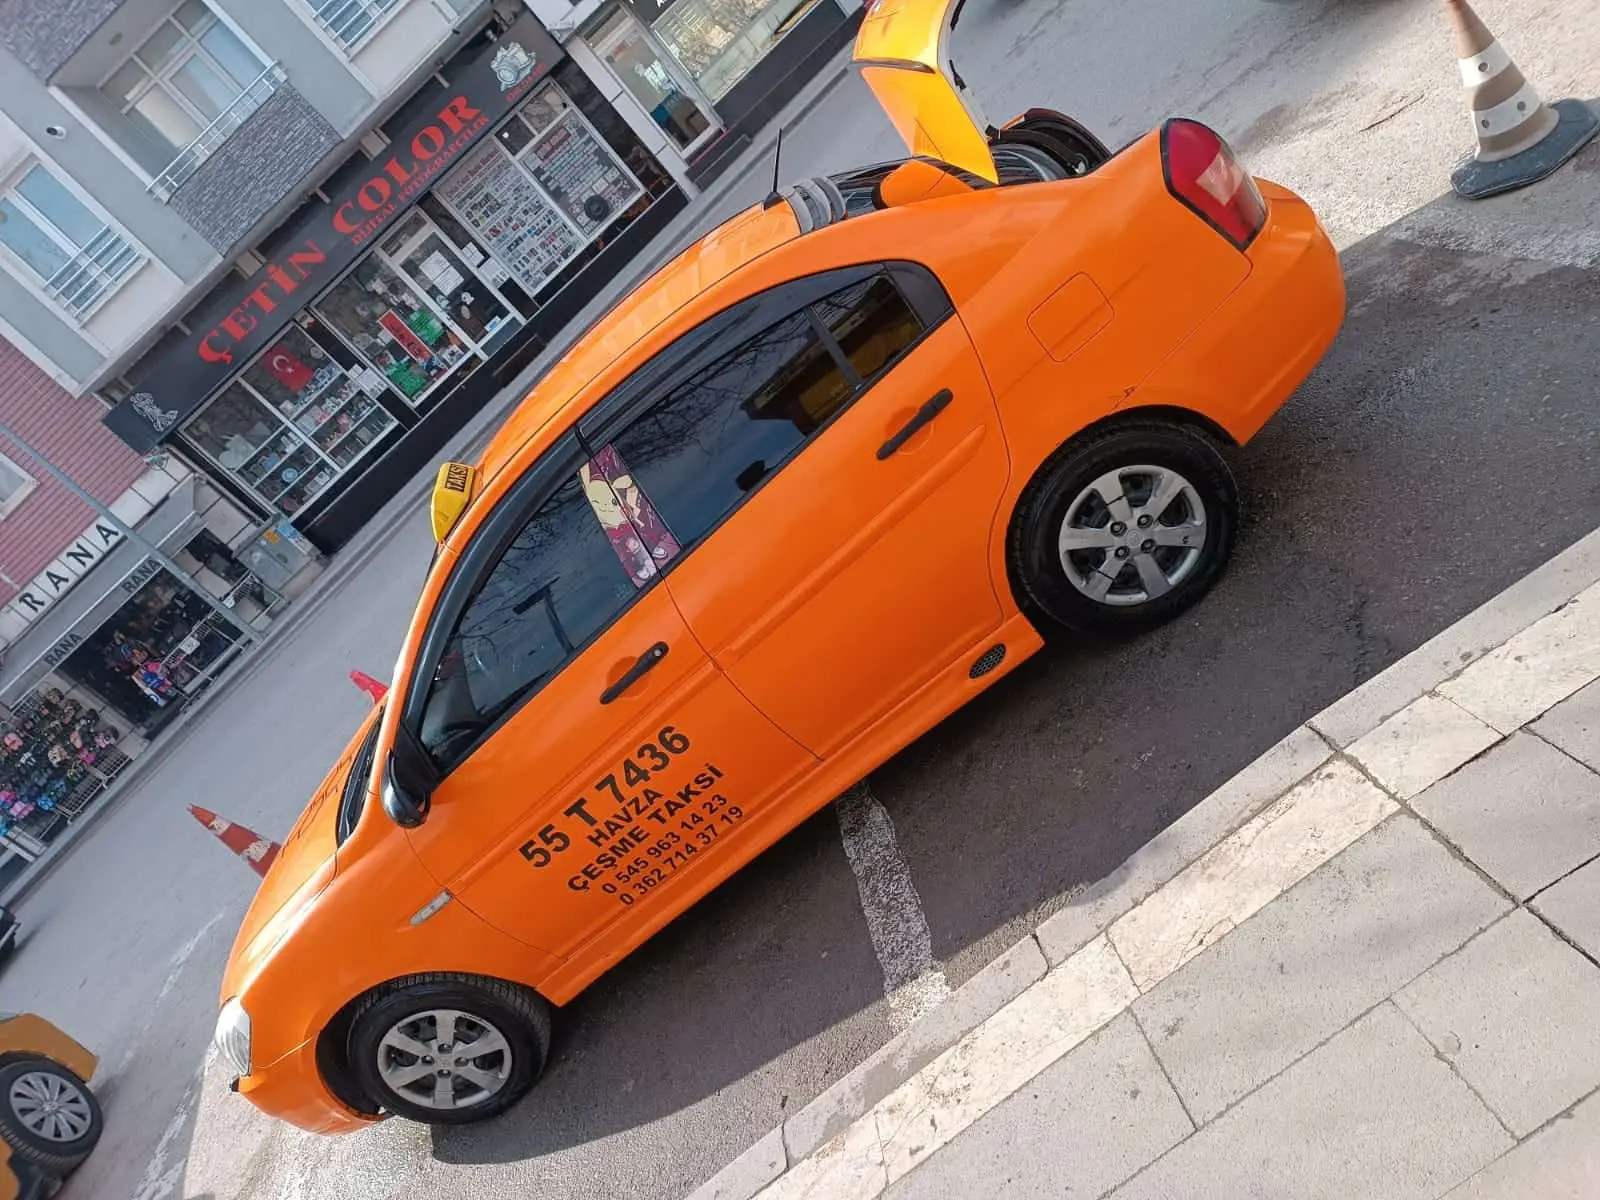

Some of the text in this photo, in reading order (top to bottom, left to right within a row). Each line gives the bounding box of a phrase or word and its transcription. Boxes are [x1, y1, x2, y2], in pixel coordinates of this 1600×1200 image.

[198, 239, 327, 363] ÇETİN
[332, 96, 481, 235] COLOR
[18, 523, 120, 613] RANA
[121, 558, 161, 593] RANA
[44, 631, 83, 666] RANA
[519, 726, 690, 868] 55 T 7436
[567, 763, 724, 892] ÇEŞME TAKSİ
[586, 788, 664, 847] HAVZA
[601, 794, 728, 895] 0 545 963 14 23
[619, 806, 744, 905] 0 362 714 37 19
